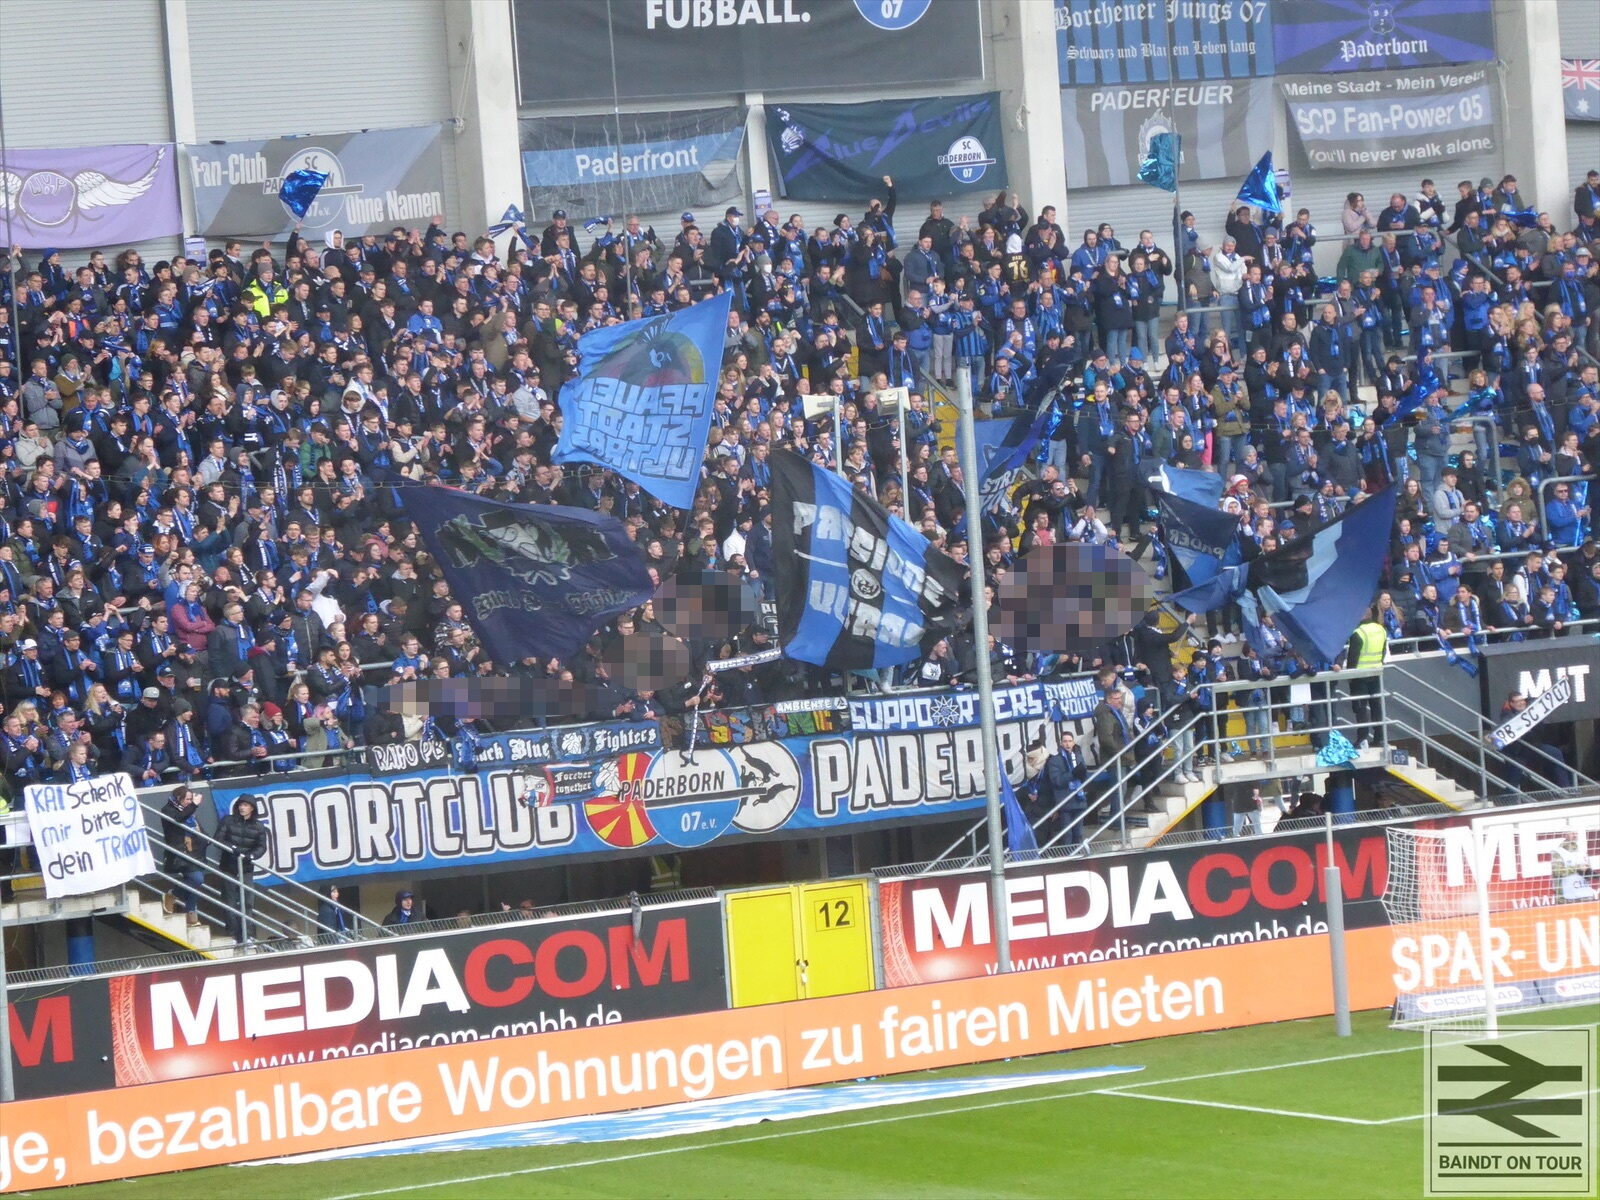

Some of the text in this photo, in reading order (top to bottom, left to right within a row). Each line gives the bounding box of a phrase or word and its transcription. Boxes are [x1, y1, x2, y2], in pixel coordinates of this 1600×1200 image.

[881, 0, 901, 19] 07
[1054, 2, 1157, 30] Borchener
[1240, 1, 1267, 23] 07
[1067, 45, 1114, 60] Schwarz
[1117, 44, 1137, 58] und
[1172, 44, 1189, 56] ein
[1192, 40, 1227, 55] Leben
[1231, 40, 1256, 55] lang
[1340, 38, 1428, 62] Paderborn
[1285, 79, 1333, 96] Meine
[1337, 79, 1380, 94] Stadt
[1396, 73, 1435, 91] Mein
[1440, 70, 1484, 88] Verein
[1091, 85, 1233, 112] PADERFEUER
[1297, 94, 1483, 135] SCP Fan-Power 05
[939, 152, 982, 164] PADERBORN
[962, 140, 971, 150] SC
[1350, 148, 1397, 163] never
[1402, 143, 1441, 159] walk
[1446, 137, 1493, 156] alone
[191, 152, 267, 187] Fan-Club
[304, 155, 318, 169] SC
[576, 145, 698, 178] Paderfront
[963, 168, 972, 178] 07
[346, 189, 442, 225] Ohne Namen
[777, 698, 832, 714] AMBIENTE
[1521, 709, 1539, 728] SC
[1537, 680, 1571, 714] 1907
[509, 738, 551, 762] Blue
[593, 727, 657, 752] Fighters
[554, 770, 592, 783] Forever
[811, 718, 1100, 818] PADERBOR
[31, 774, 125, 814] KAI Schenk
[555, 782, 592, 795] together
[620, 770, 725, 803] PADERBORN
[81, 809, 121, 835] bitte
[681, 811, 717, 832] 07 e.V.
[48, 826, 147, 880] dein TRIKOT
[911, 836, 1388, 952] MEDIACOM
[818, 900, 851, 929] 12
[150, 918, 690, 1050] MEDIACOM
[87, 1080, 422, 1166] bezahlbare
[438, 1033, 784, 1117] Wohnungen
[800, 1024, 864, 1071] zu
[879, 1000, 1030, 1058] fairen
[1046, 975, 1224, 1037] Mieten
